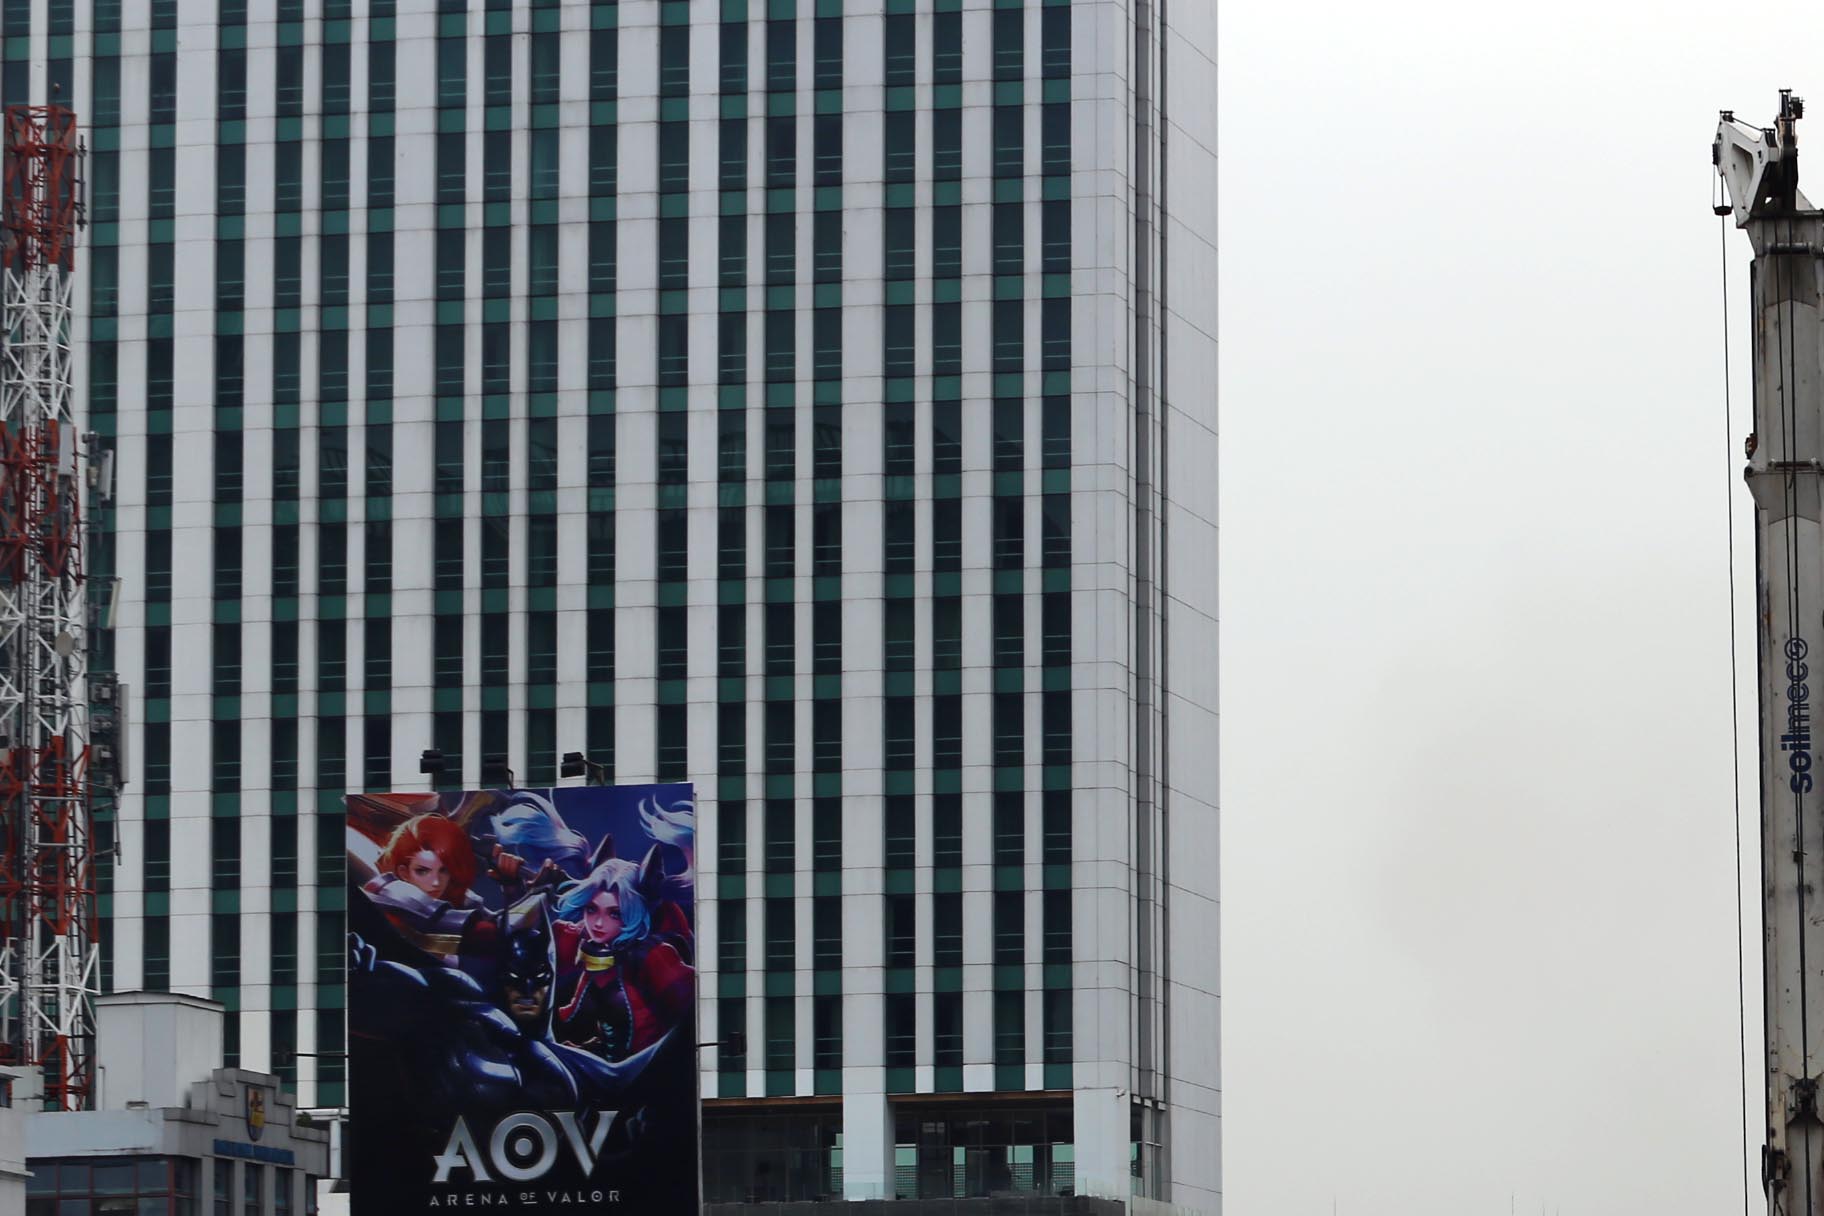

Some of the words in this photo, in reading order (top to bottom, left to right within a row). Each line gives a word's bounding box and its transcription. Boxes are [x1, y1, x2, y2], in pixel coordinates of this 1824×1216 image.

[1780, 661, 1813, 794] soilmec
[431, 1110, 620, 1182] AOV
[429, 1193, 509, 1207] ARENA
[519, 1191, 537, 1204] OF
[547, 1190, 620, 1203] VALOR
